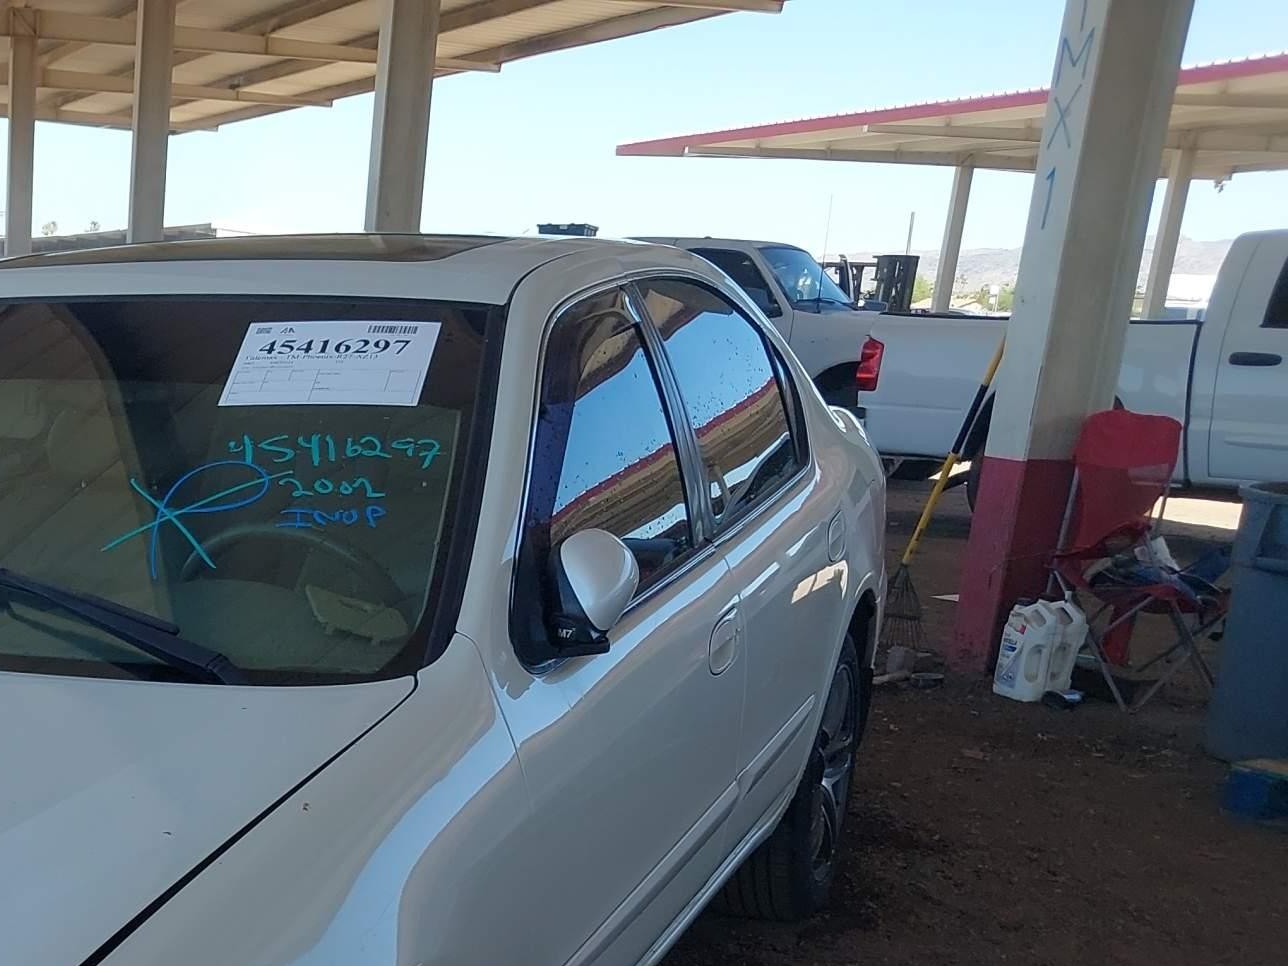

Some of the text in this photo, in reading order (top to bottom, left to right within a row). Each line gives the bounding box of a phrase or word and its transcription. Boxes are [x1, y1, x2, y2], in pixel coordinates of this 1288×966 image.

[258, 338, 412, 355] 45416297
[227, 432, 444, 470] 45416297
[274, 504, 388, 529] INOP
